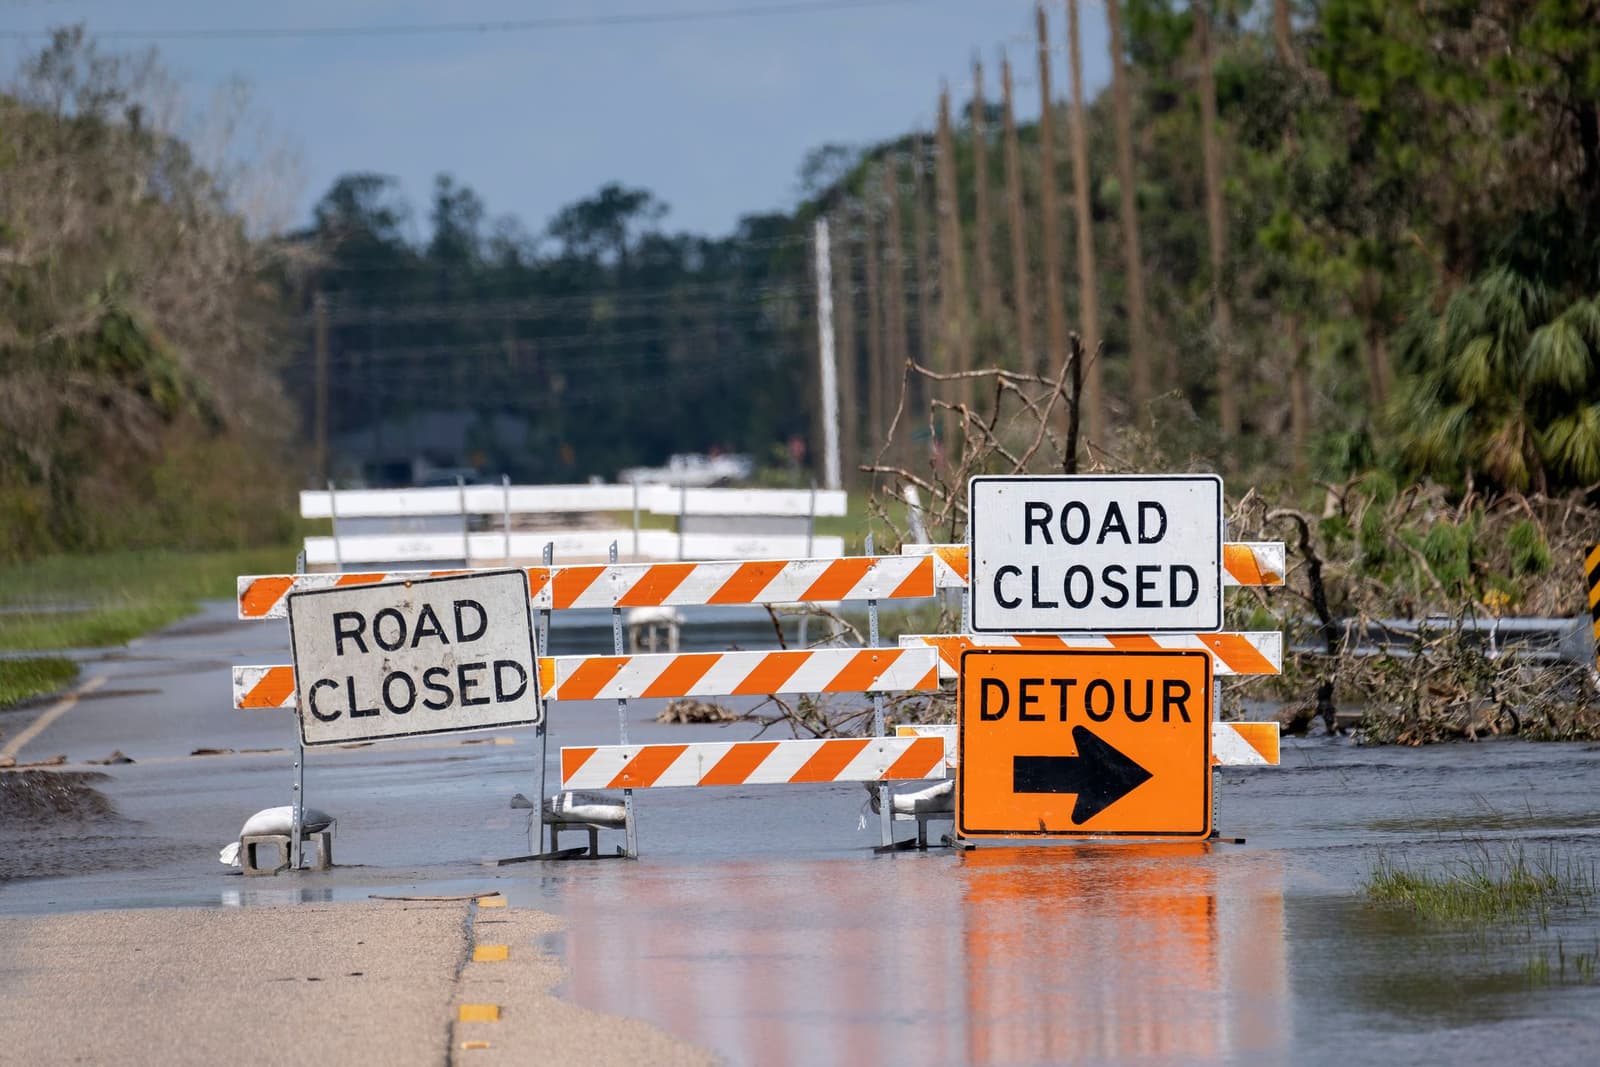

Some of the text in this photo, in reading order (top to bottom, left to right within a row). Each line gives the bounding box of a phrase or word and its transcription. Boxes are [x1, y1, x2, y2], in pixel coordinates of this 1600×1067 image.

[1024, 500, 1168, 545] ROAD
[993, 564, 1199, 609] CLOSED
[332, 599, 488, 656] ROAD
[308, 659, 528, 722] CLOSED
[980, 677, 1192, 723] DETOUR
